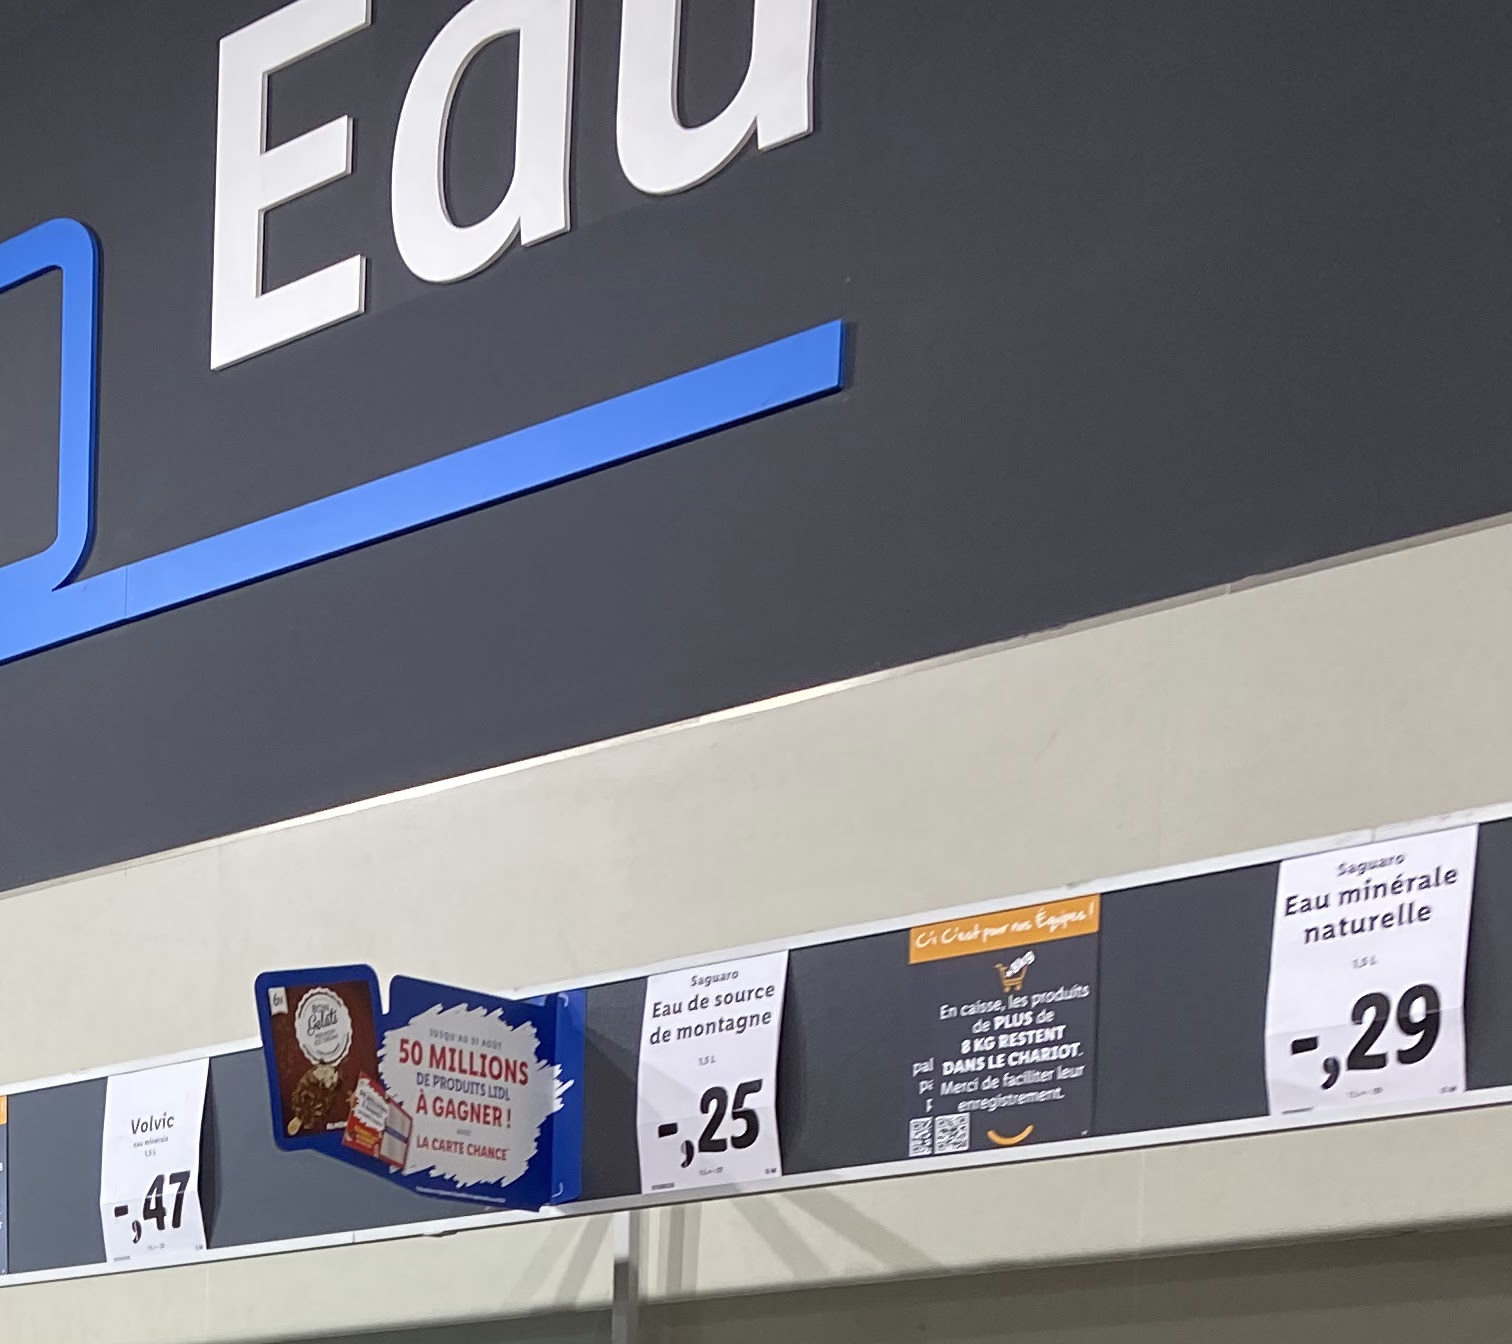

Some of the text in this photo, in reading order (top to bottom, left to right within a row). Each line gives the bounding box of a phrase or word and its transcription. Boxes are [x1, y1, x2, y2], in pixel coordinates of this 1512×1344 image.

[210, 0, 818, 371] Eau
[1337, 853, 1407, 877] Saguaro
[1284, 866, 1459, 917] Eau minérale
[1303, 901, 1432, 945] naturelle
[690, 970, 739, 988] Saguaro
[652, 984, 775, 1019] Eau de source
[940, 984, 1090, 1020] En caisse, les produits
[649, 1010, 772, 1046] de montagne
[972, 1008, 1055, 1034] de PLUS de
[1290, 983, 1441, 1090] -,29
[961, 1024, 1067, 1054] 8 KG RESTENT
[399, 1038, 529, 1086] 50 MILLIONS
[941, 1042, 1085, 1076] DANS LE CHARIOT.
[416, 1072, 511, 1101] DE PRODUITS LIDL
[940, 1077, 979, 1096] Merci
[981, 1074, 999, 1091] de
[1002, 1068, 1055, 1088] faciliter
[1056, 1064, 1086, 1080] leur
[415, 1088, 428, 1115] À
[432, 1096, 503, 1128] GAGNER
[506, 1108, 512, 1129] !
[957, 1086, 1066, 1113] enregistrement.
[130, 1112, 175, 1136] Volvic
[657, 1078, 764, 1169] -,25
[416, 1135, 508, 1161] LA CARTE CHANCE
[114, 1170, 191, 1244] -,47
